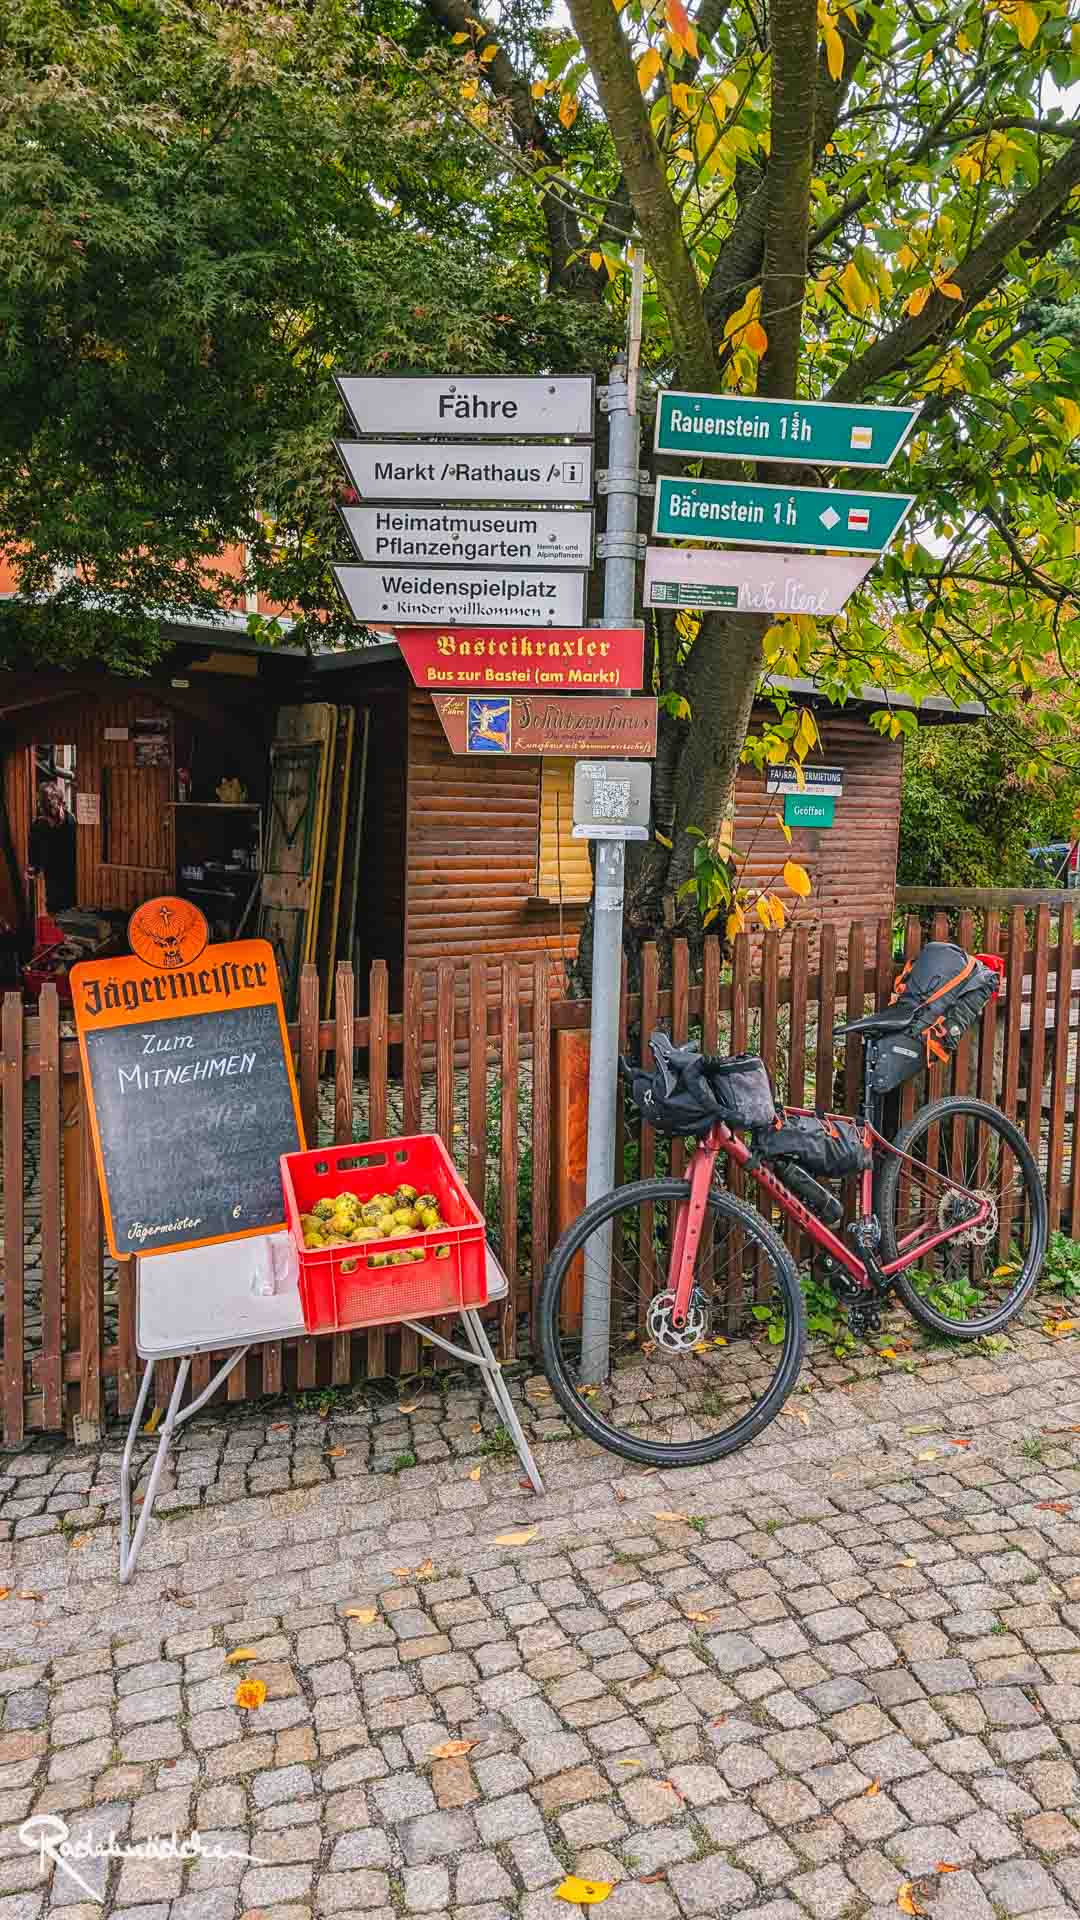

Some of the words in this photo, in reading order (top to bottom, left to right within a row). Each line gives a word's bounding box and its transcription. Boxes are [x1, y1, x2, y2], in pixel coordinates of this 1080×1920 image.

[438, 394, 518, 419] Fähre
[670, 409, 770, 439] Rauenstein
[374, 463, 435, 481] Markt
[455, 463, 541, 482] Rathaus
[669, 493, 764, 524] Bärenstein
[375, 512, 538, 534] Heimatmuseum
[375, 537, 532, 561] Pflanzengarten
[381, 576, 557, 600] Weidenspielplatz
[397, 601, 445, 616] Kinder
[448, 603, 542, 618] willkommen
[436, 635, 611, 657] Basteikraxler
[427, 667, 454, 681] Bus
[457, 669, 481, 682] zur
[485, 668, 531, 682] Bastei
[535, 669, 563, 684] (am
[568, 668, 620, 684] Markt)
[82, 961, 267, 1016] Jägermeister
[141, 1033, 195, 1056] Zum
[118, 1052, 257, 1095] MITNEHMEN
[127, 1217, 201, 1243] Jägermeister
